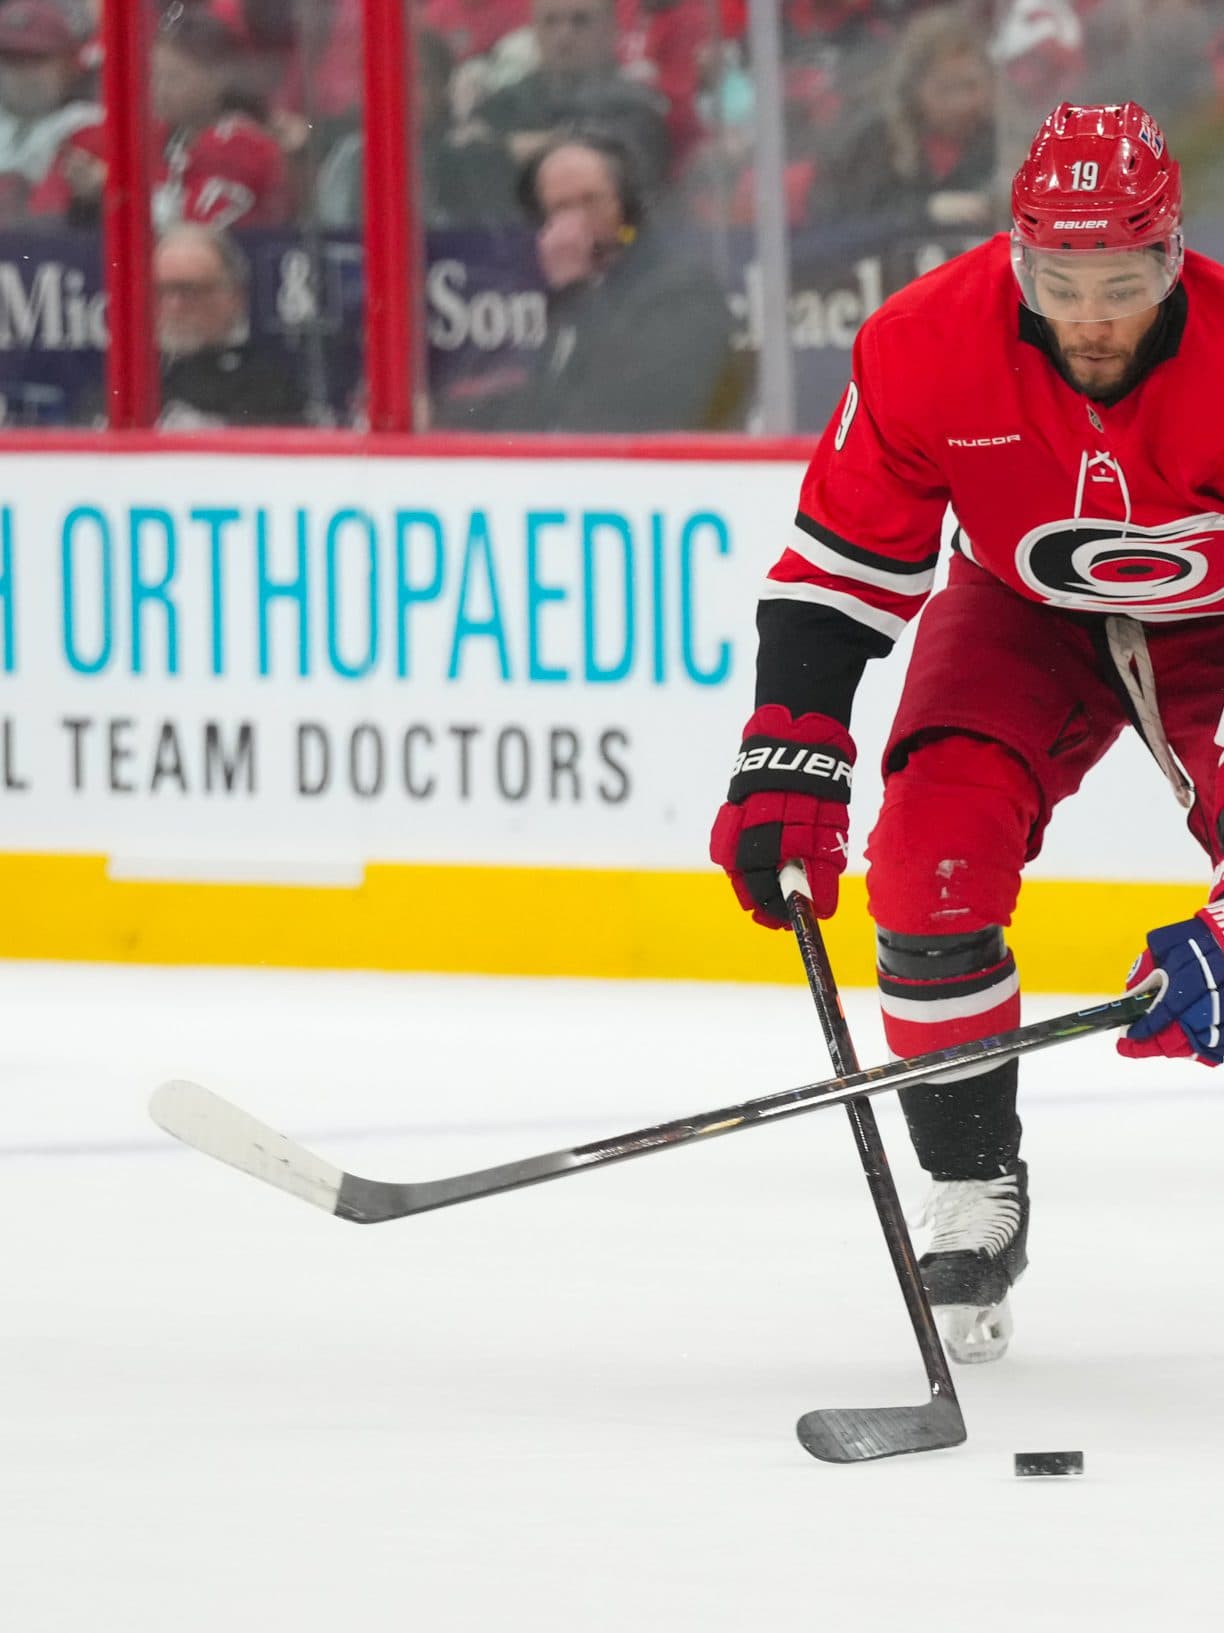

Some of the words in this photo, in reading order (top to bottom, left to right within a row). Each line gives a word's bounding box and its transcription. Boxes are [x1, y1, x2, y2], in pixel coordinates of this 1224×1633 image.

[1071, 161, 1099, 191] 19
[1053, 220, 1108, 229] BAUER
[948, 434, 1021, 447] NUCOR
[62, 506, 732, 685] ORTHOPAEDIC
[62, 719, 256, 793] TEAM
[298, 723, 631, 802] DOCTORS
